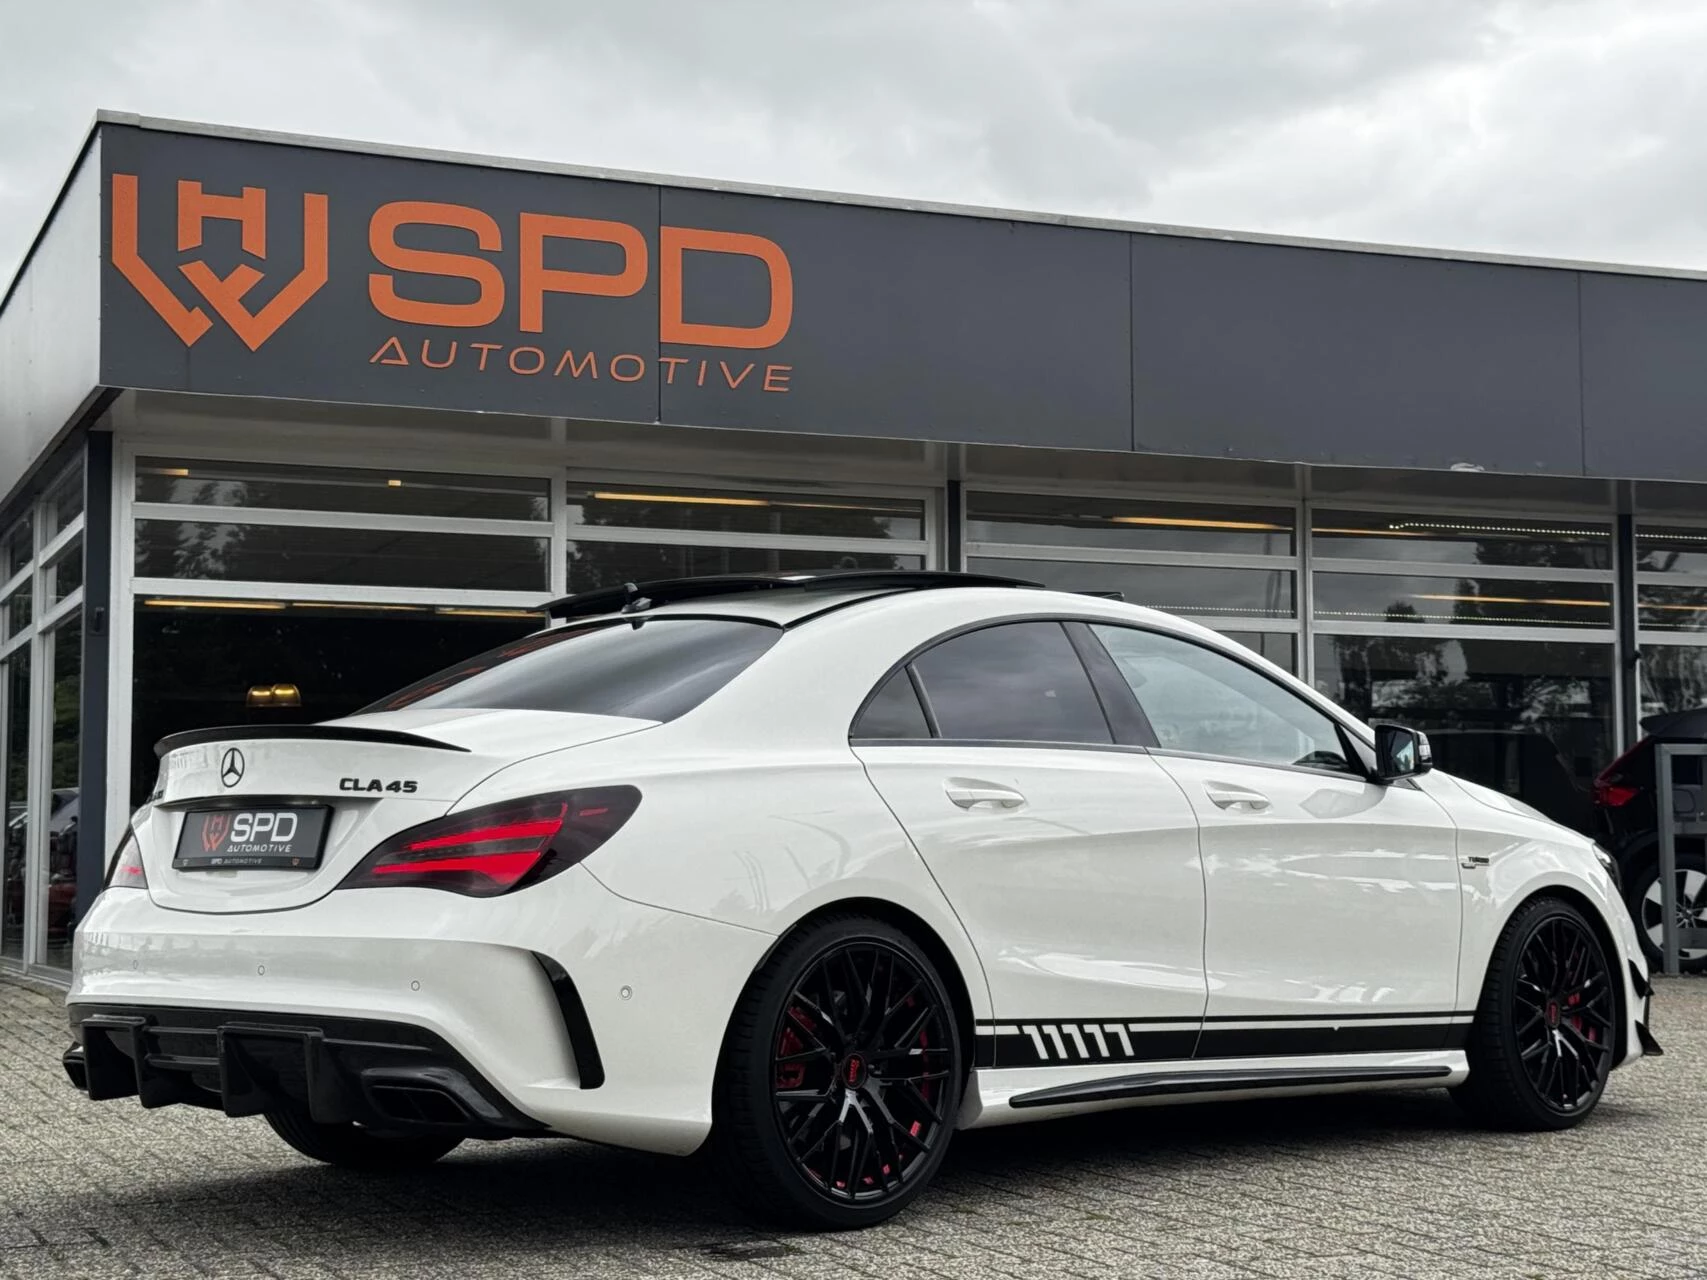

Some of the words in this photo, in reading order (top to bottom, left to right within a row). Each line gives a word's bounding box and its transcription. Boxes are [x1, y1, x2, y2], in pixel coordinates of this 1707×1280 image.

[368, 200, 793, 349] SPD
[369, 336, 793, 392] AUTOMOTIVE
[226, 844, 293, 853] AUTOMOTIVE
[230, 812, 298, 843] SPD
